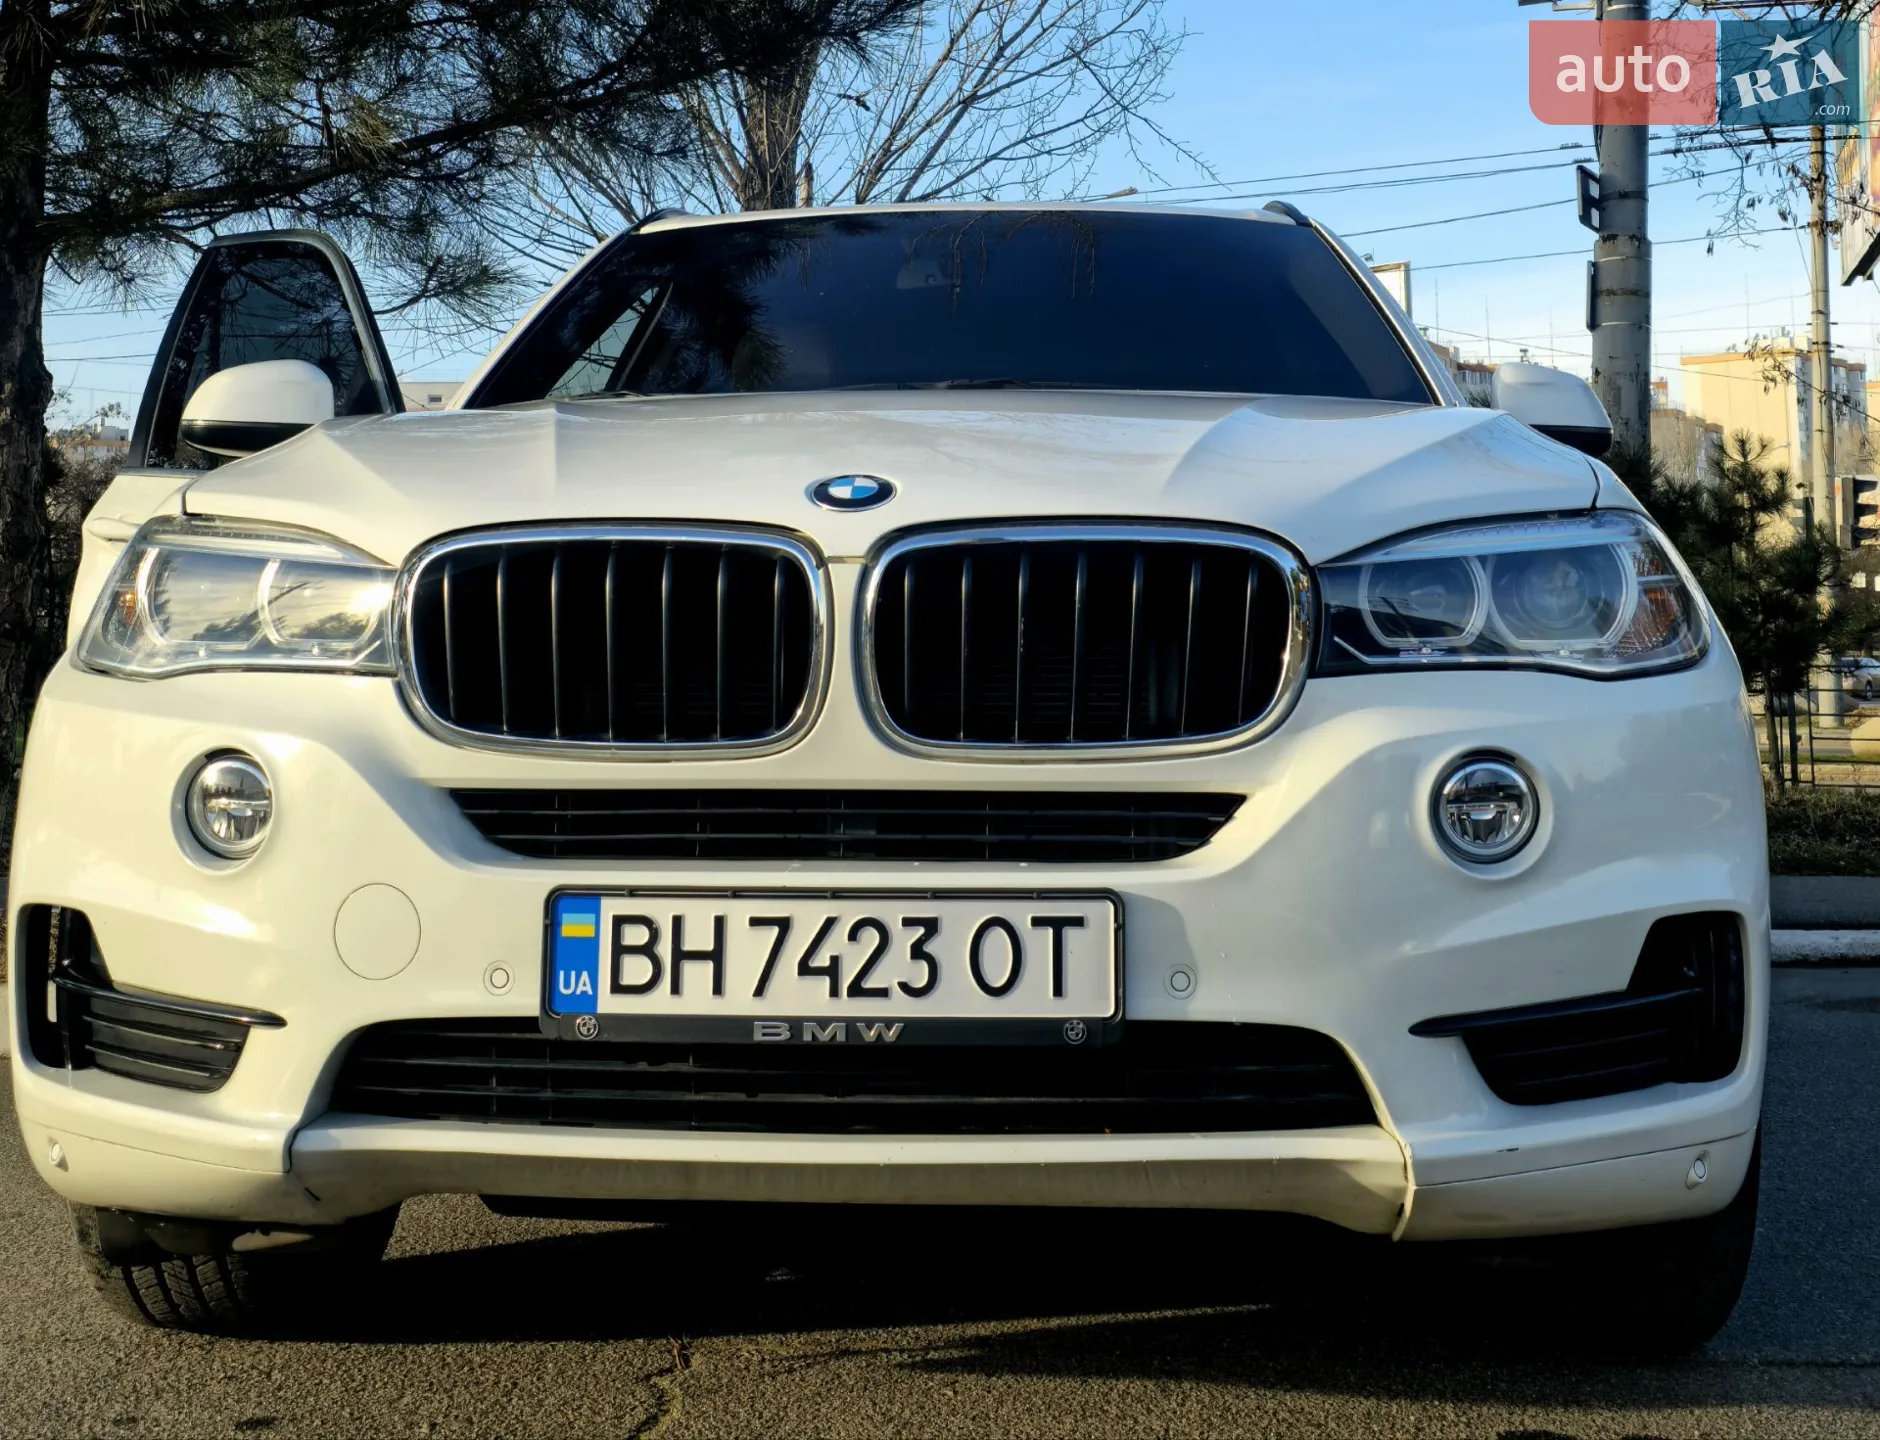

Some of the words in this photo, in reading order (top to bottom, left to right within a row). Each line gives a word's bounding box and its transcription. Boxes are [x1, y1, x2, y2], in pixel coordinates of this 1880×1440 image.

[609, 914, 726, 997] BH
[748, 915, 940, 999] 7423
[968, 915, 1085, 998] OT
[559, 970, 593, 996] UA
[753, 1021, 904, 1042] BMW
